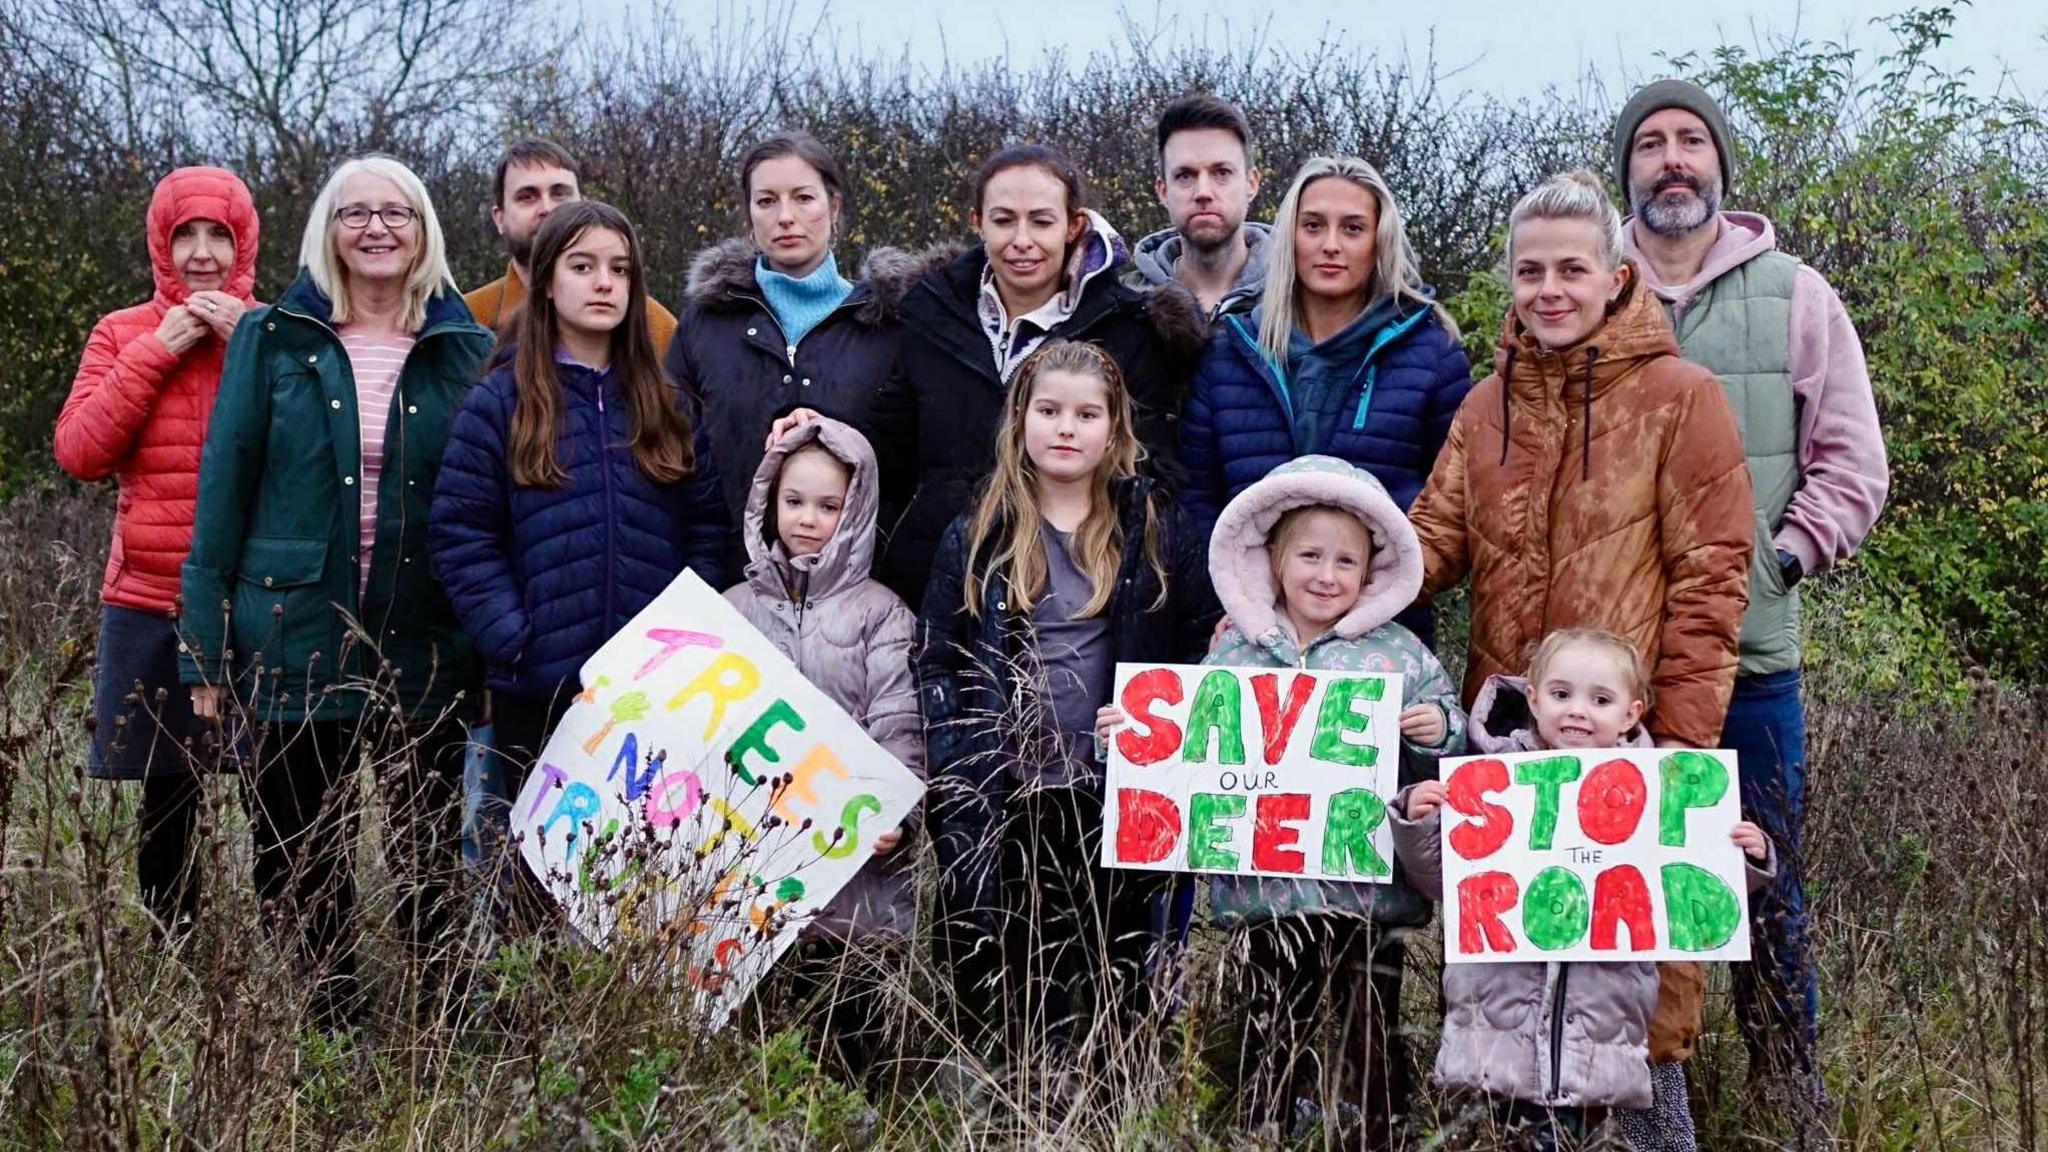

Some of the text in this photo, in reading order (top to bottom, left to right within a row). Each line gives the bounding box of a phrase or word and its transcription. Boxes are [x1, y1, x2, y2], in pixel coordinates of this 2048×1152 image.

[634, 628, 882, 859] TREES
[1116, 668, 1385, 766] SAVE
[606, 732, 758, 858] NOT
[1220, 772, 1279, 790] OUR
[1446, 751, 1729, 860] STOP
[1116, 788, 1391, 876] DEER
[1564, 847, 1602, 864] THE
[1458, 862, 1741, 954] ROAD
